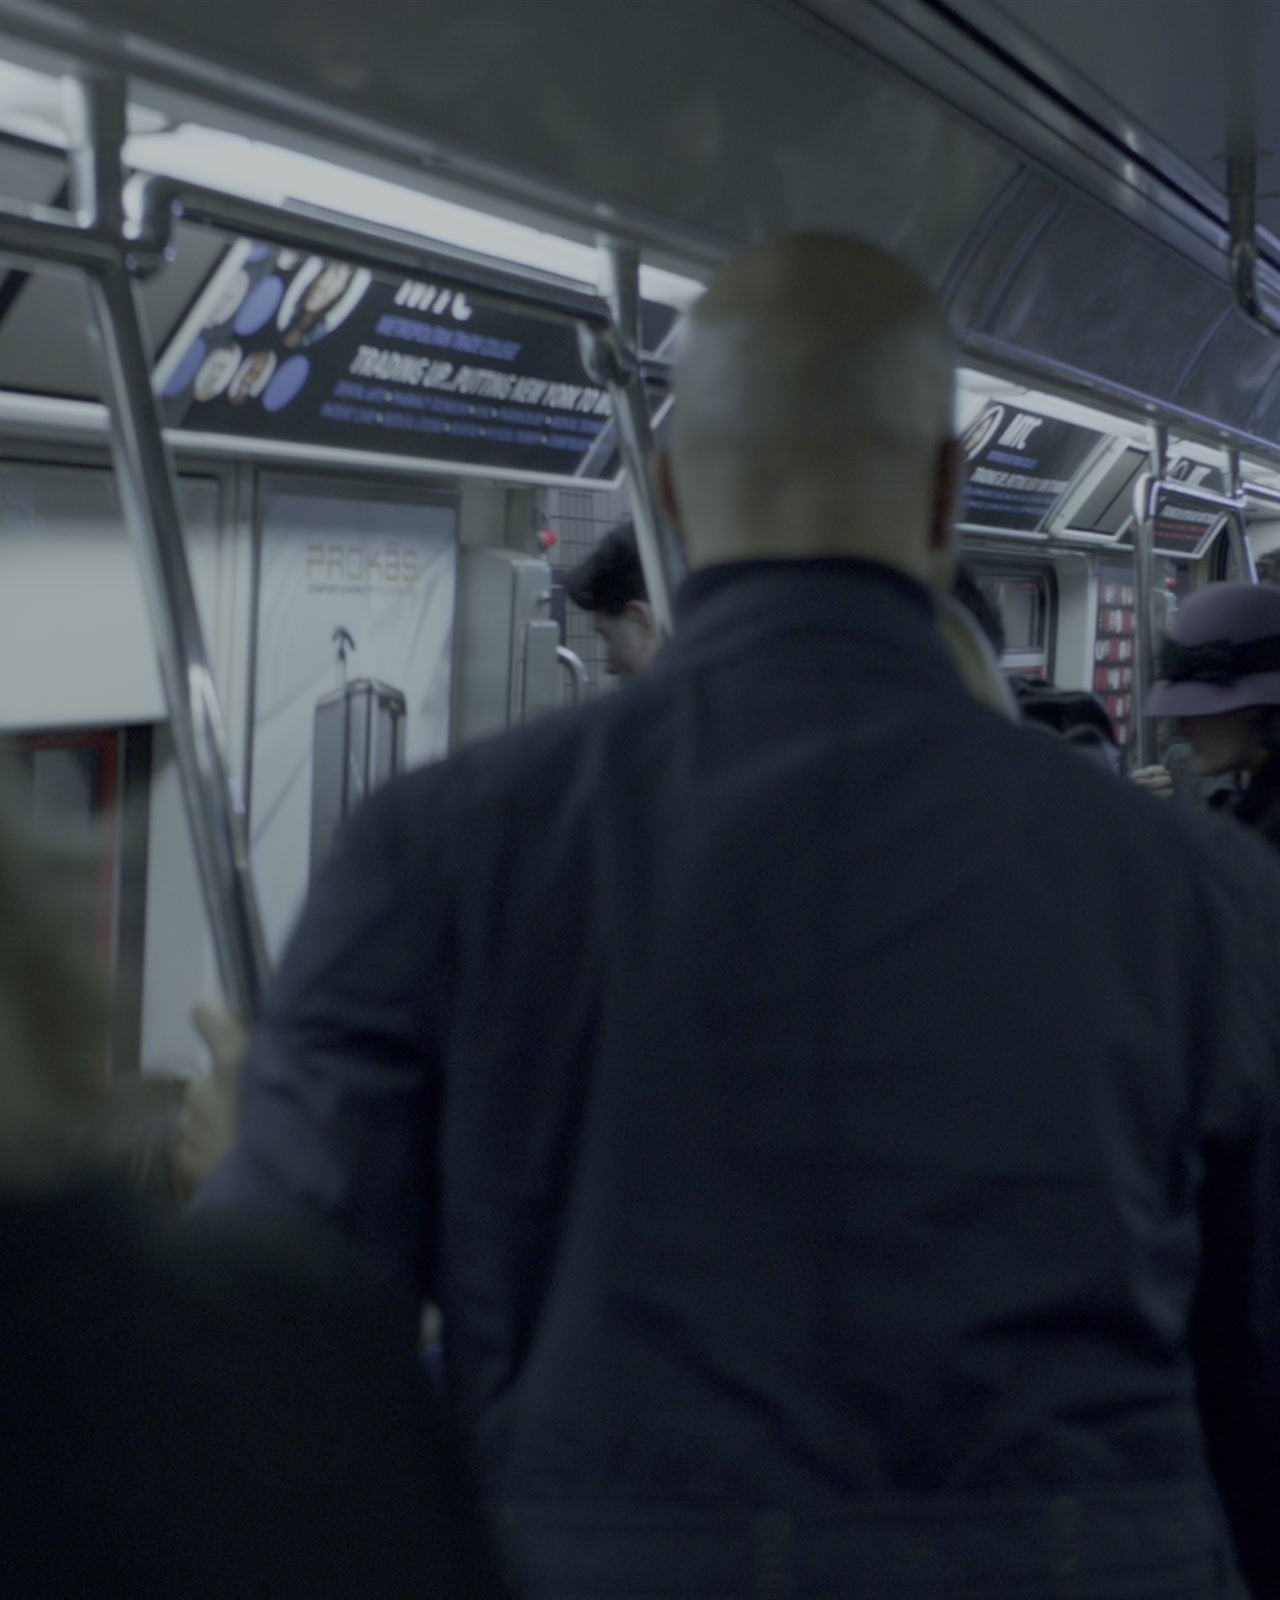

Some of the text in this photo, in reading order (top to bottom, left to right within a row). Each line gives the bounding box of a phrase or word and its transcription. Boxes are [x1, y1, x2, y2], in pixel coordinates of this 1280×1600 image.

[349, 344, 431, 386] TRADING
[508, 376, 550, 405] NEW
[541, 382, 584, 411] YORK
